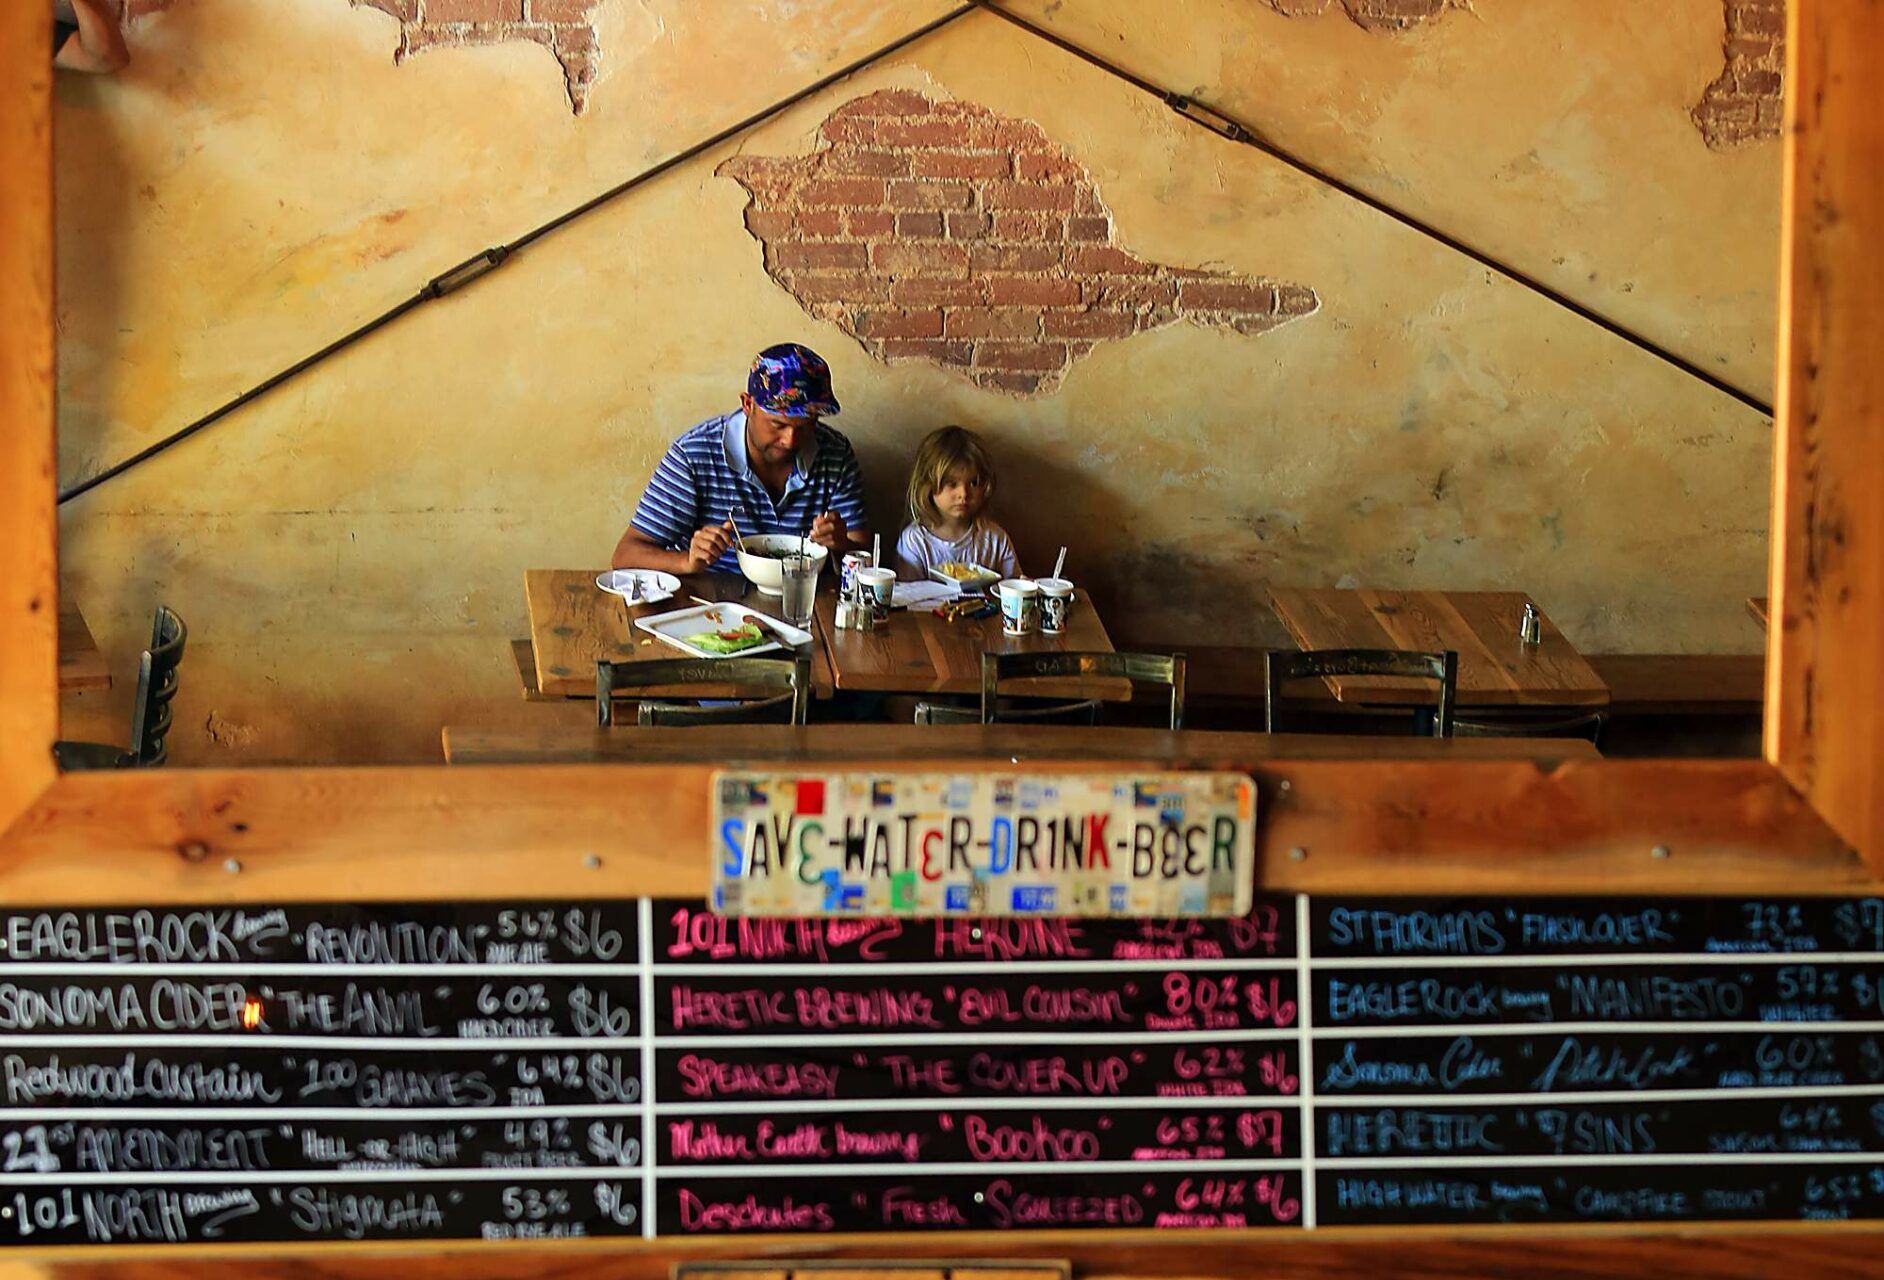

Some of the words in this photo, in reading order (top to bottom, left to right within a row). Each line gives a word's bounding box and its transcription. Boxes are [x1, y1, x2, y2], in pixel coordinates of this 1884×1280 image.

[561, 905, 623, 961] $6
[667, 907, 736, 960] 101
[569, 982, 631, 1037] $6
[1245, 976, 1297, 1027] $6
[586, 1052, 640, 1103] $6
[1258, 1050, 1298, 1095] $6
[586, 1120, 640, 1166] $6
[13, 1187, 80, 1236] 101
[593, 1181, 638, 1226] $6
[1254, 1173, 1299, 1222] $6
